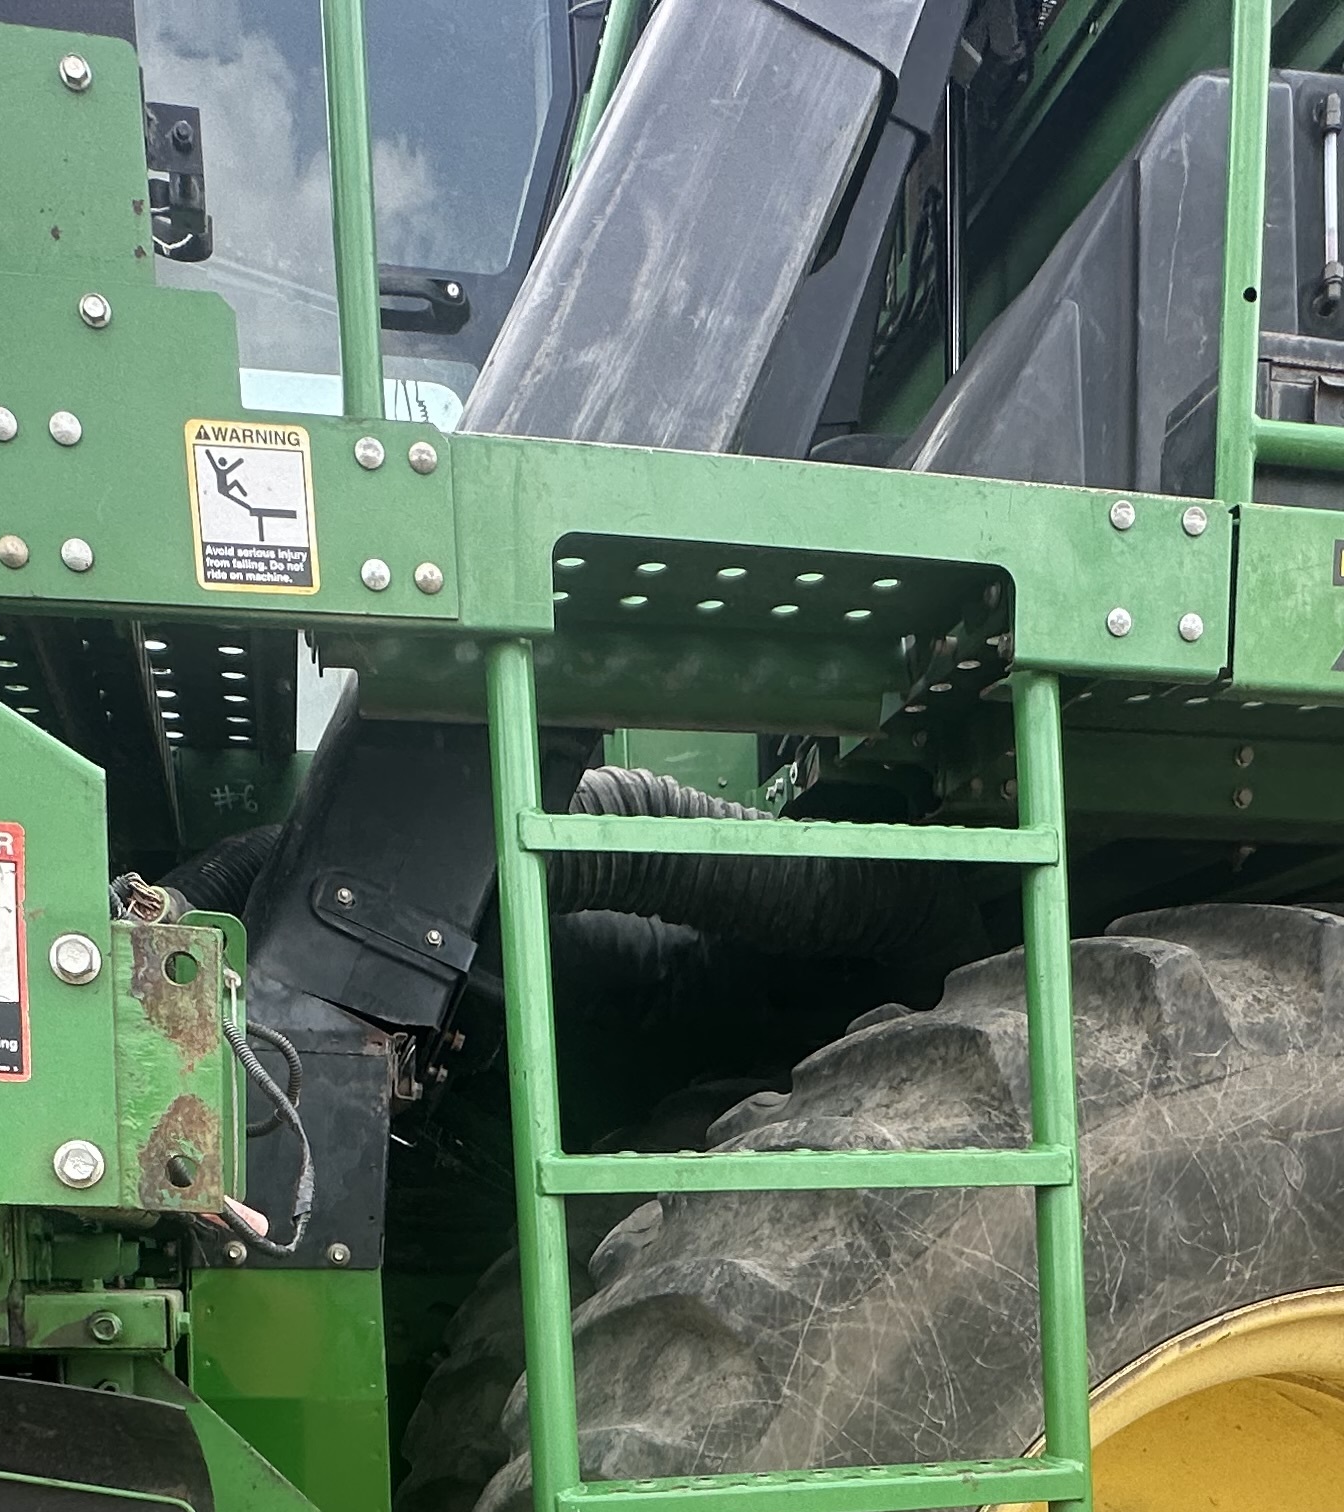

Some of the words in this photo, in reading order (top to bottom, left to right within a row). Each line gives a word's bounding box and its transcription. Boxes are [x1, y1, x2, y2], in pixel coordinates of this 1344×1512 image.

[211, 426, 300, 446] WARNING
[205, 545, 235, 556] Avoid
[237, 548, 275, 559] serious
[278, 549, 307, 561] injury
[206, 557, 230, 568] from
[233, 559, 268, 571] falling.
[270, 561, 285, 571] Do
[287, 561, 305, 571] not
[207, 570, 228, 580] ride
[230, 572, 243, 580] on
[246, 571, 293, 583] machine.
